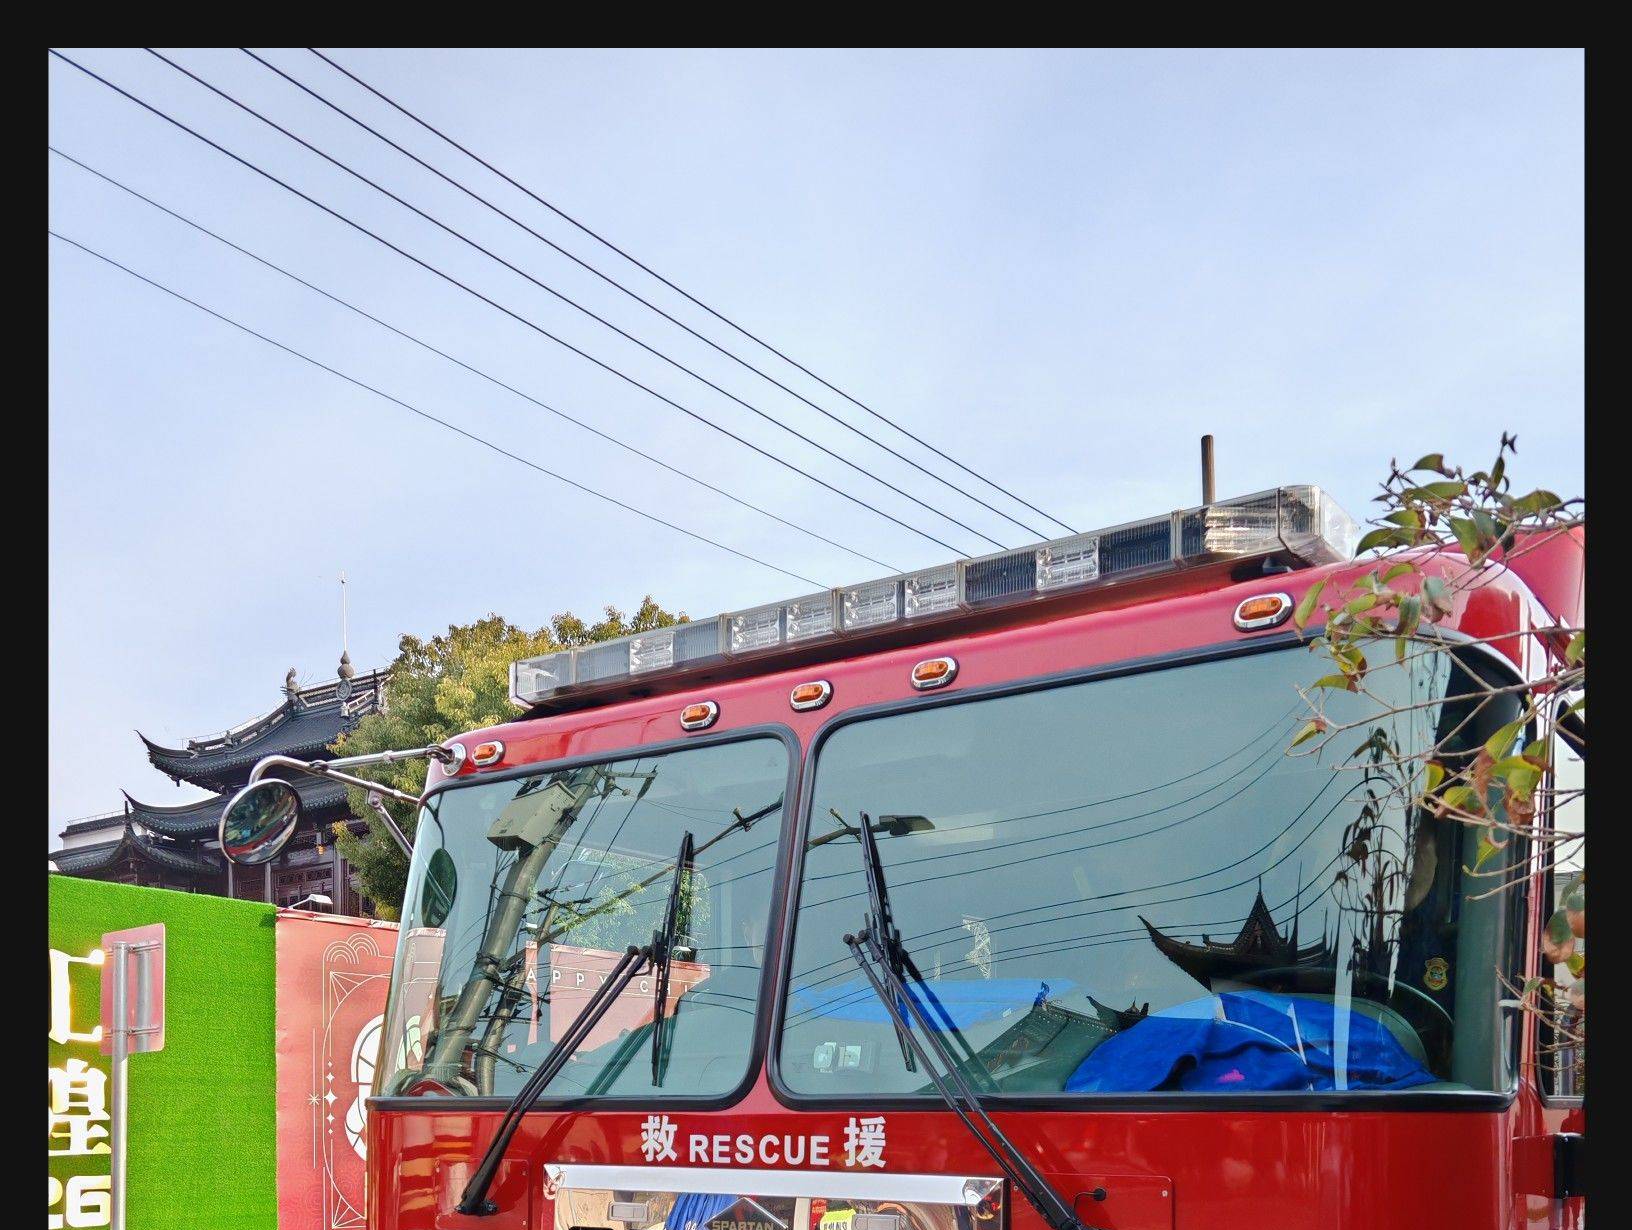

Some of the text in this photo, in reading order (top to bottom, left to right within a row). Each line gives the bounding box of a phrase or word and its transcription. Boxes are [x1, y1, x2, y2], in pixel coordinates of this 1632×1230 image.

[640, 1115, 887, 1168] 救 RESCUE 援
